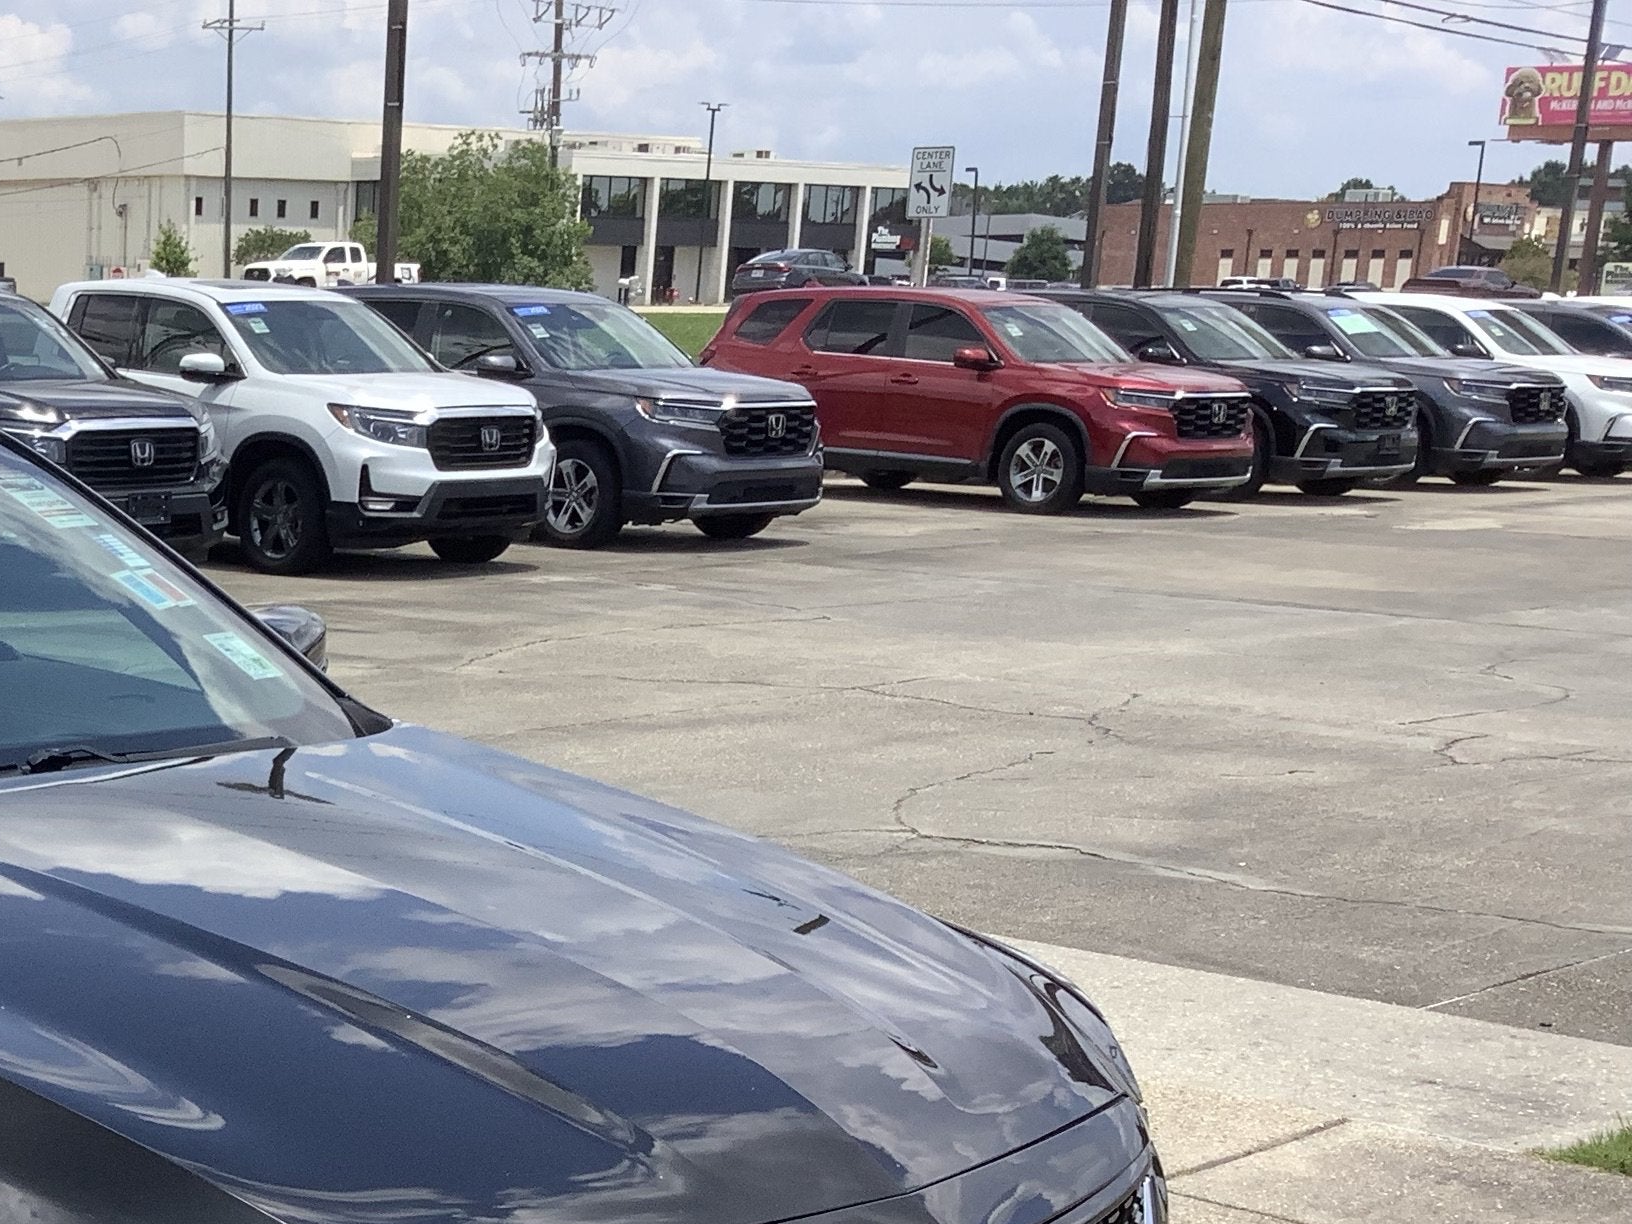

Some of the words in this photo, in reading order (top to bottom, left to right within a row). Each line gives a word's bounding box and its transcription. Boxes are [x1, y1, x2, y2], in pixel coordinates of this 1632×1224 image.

[1544, 70, 1608, 97] RUF
[915, 150, 951, 160] CENTER
[920, 160, 945, 170] LANE
[915, 205, 941, 215] ONLY
[1326, 209, 1392, 221] DUMPING
